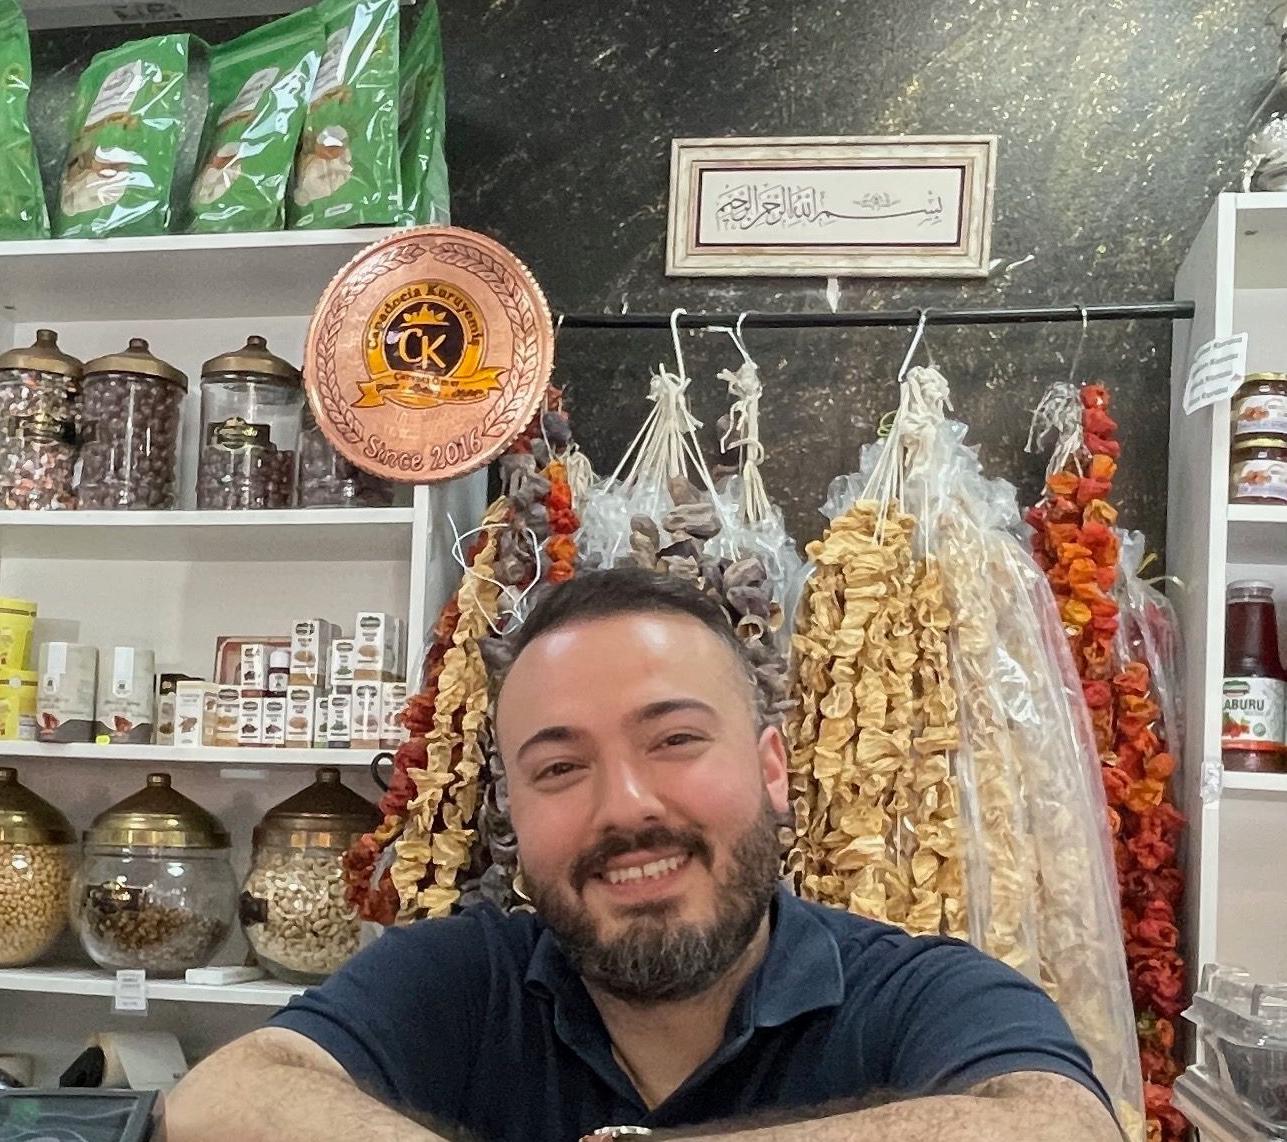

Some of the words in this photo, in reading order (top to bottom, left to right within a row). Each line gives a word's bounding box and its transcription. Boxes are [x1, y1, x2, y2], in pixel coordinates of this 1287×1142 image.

[364, 433, 426, 472] Since
[430, 431, 484, 471] 2016
[1223, 698, 1265, 712] ABURU
